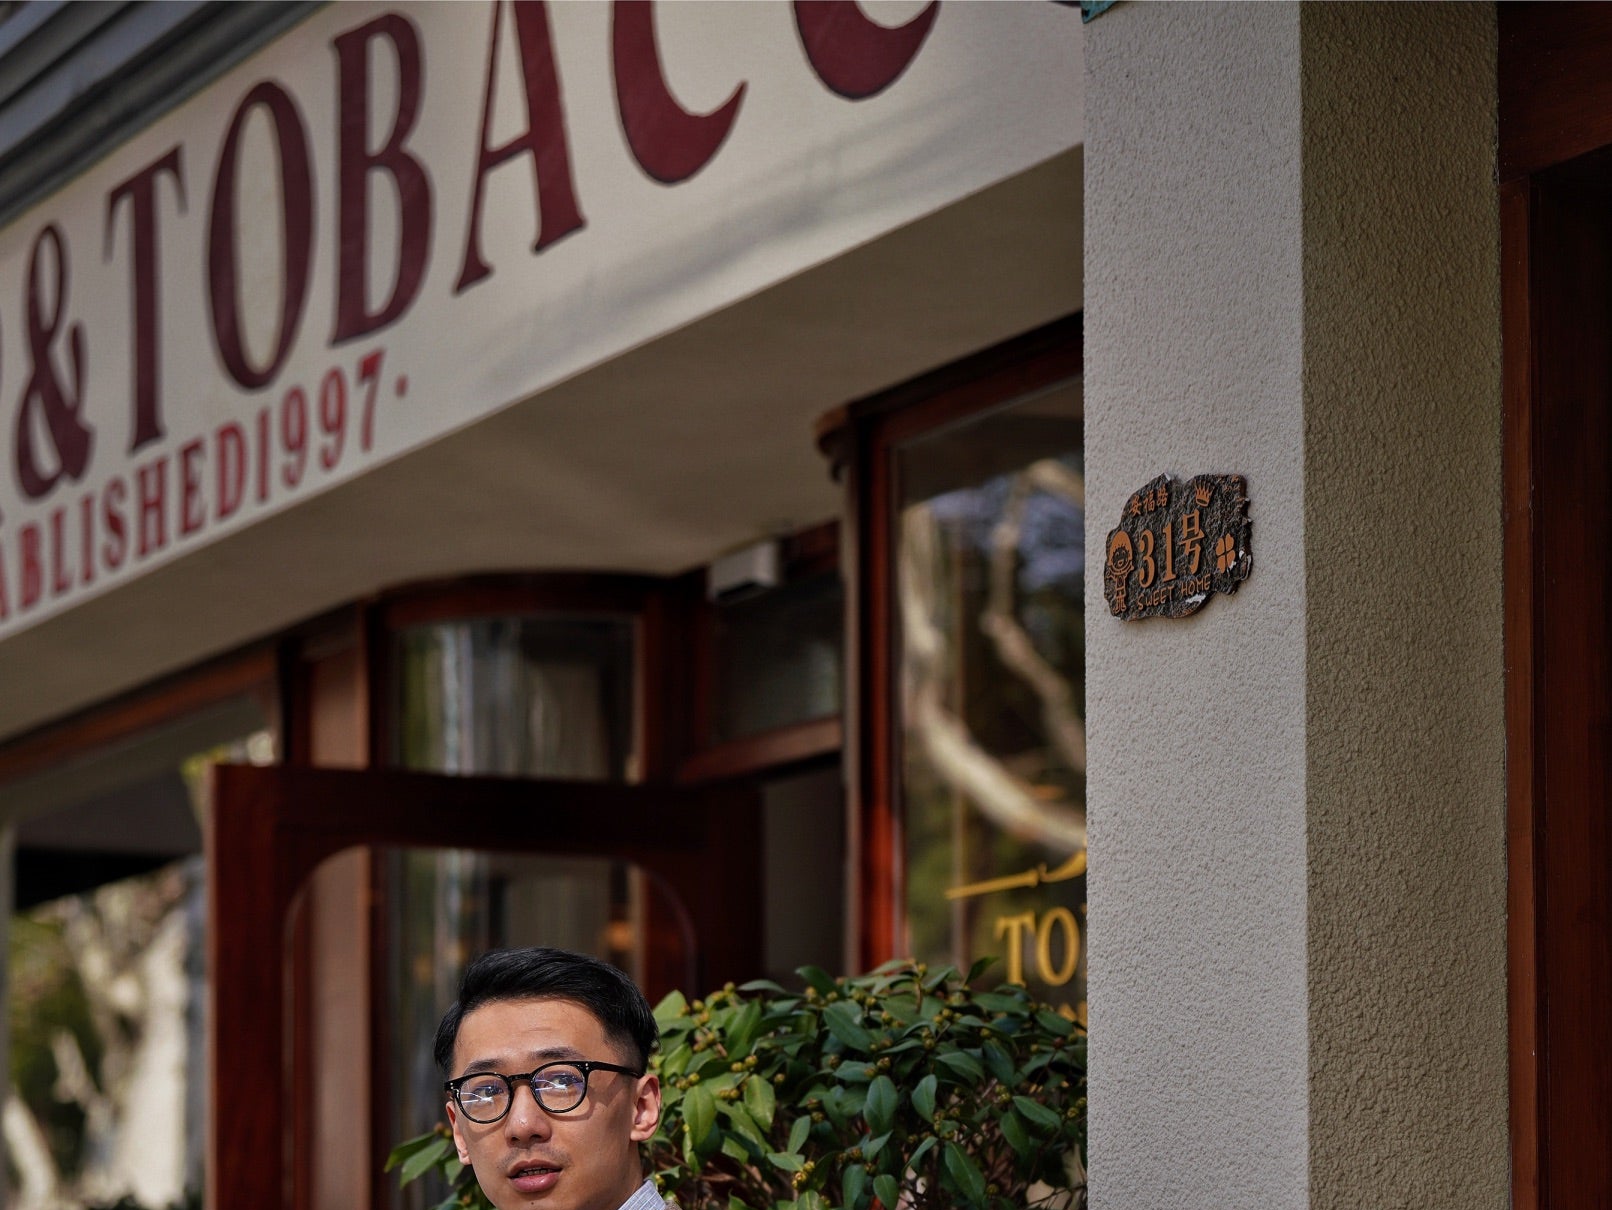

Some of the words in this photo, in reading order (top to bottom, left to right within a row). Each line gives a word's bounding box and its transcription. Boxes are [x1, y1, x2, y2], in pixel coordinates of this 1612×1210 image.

[12, 222, 98, 503] &
[103, 0, 1080, 456] TOBAC
[1138, 508, 1205, 589] 31号
[1136, 584, 1175, 611] SWEET
[1180, 573, 1211, 597] HOME
[994, 906, 1087, 989] TO
